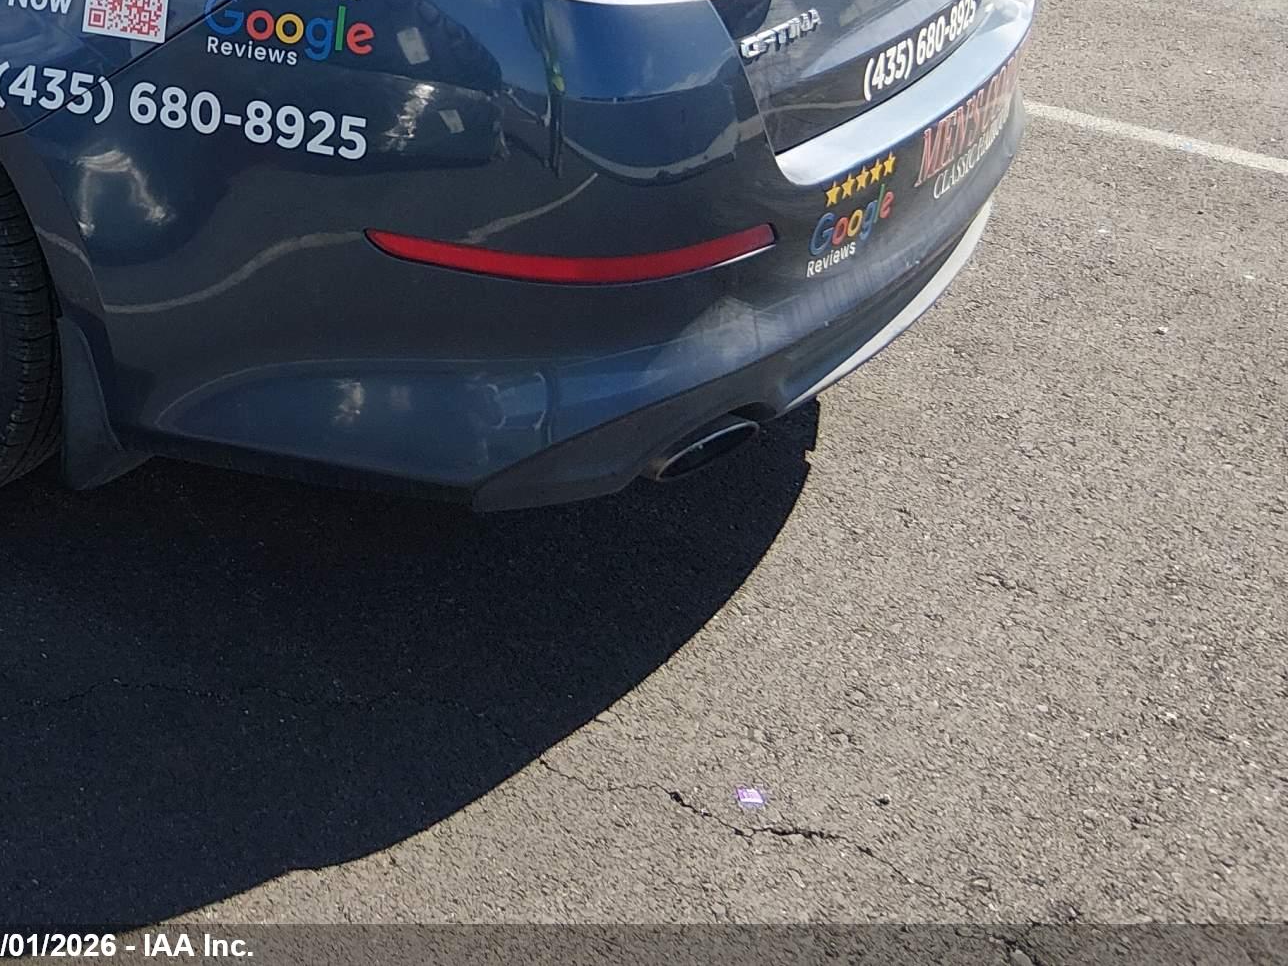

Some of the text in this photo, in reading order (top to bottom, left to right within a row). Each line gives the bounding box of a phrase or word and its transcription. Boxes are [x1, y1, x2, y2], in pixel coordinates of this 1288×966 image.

[206, 35, 299, 67] Reviews
[863, 37, 914, 102] (435)
[128, 81, 369, 161] 680-8925
[808, 182, 895, 257] Google
[806, 241, 857, 278] Reviews
